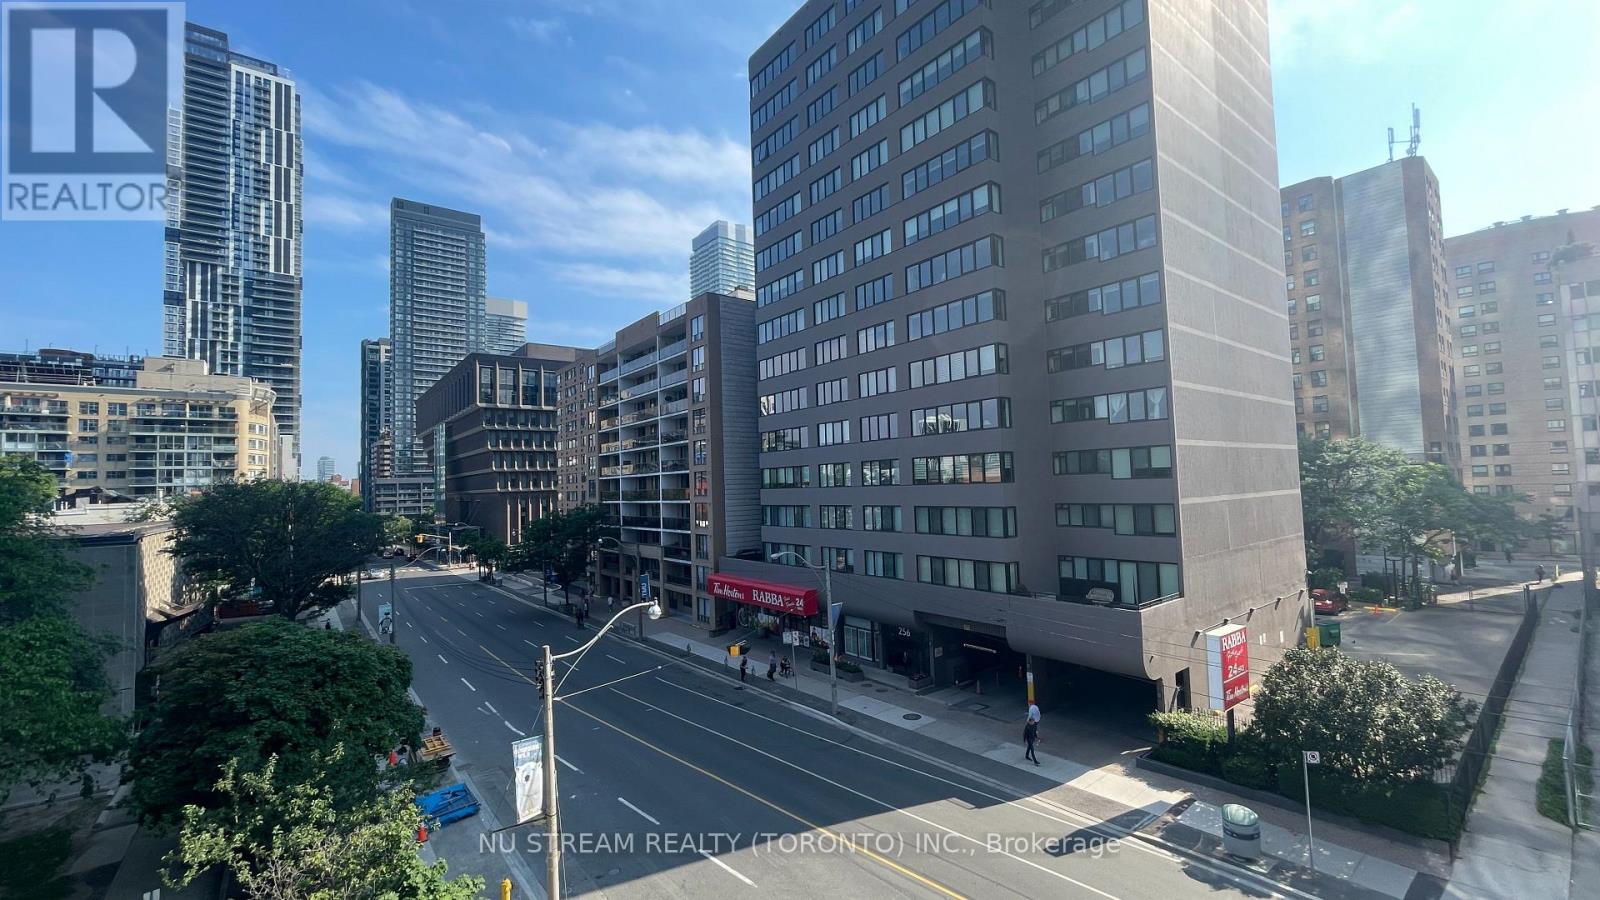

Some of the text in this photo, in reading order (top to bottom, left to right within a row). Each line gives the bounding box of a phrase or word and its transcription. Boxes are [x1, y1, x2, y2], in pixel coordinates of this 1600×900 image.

[752, 589, 784, 607] RABBA
[795, 598, 804, 607] 24
[898, 627, 911, 637] 256
[1222, 631, 1246, 652] RABBA
[1228, 663, 1238, 678] 24
